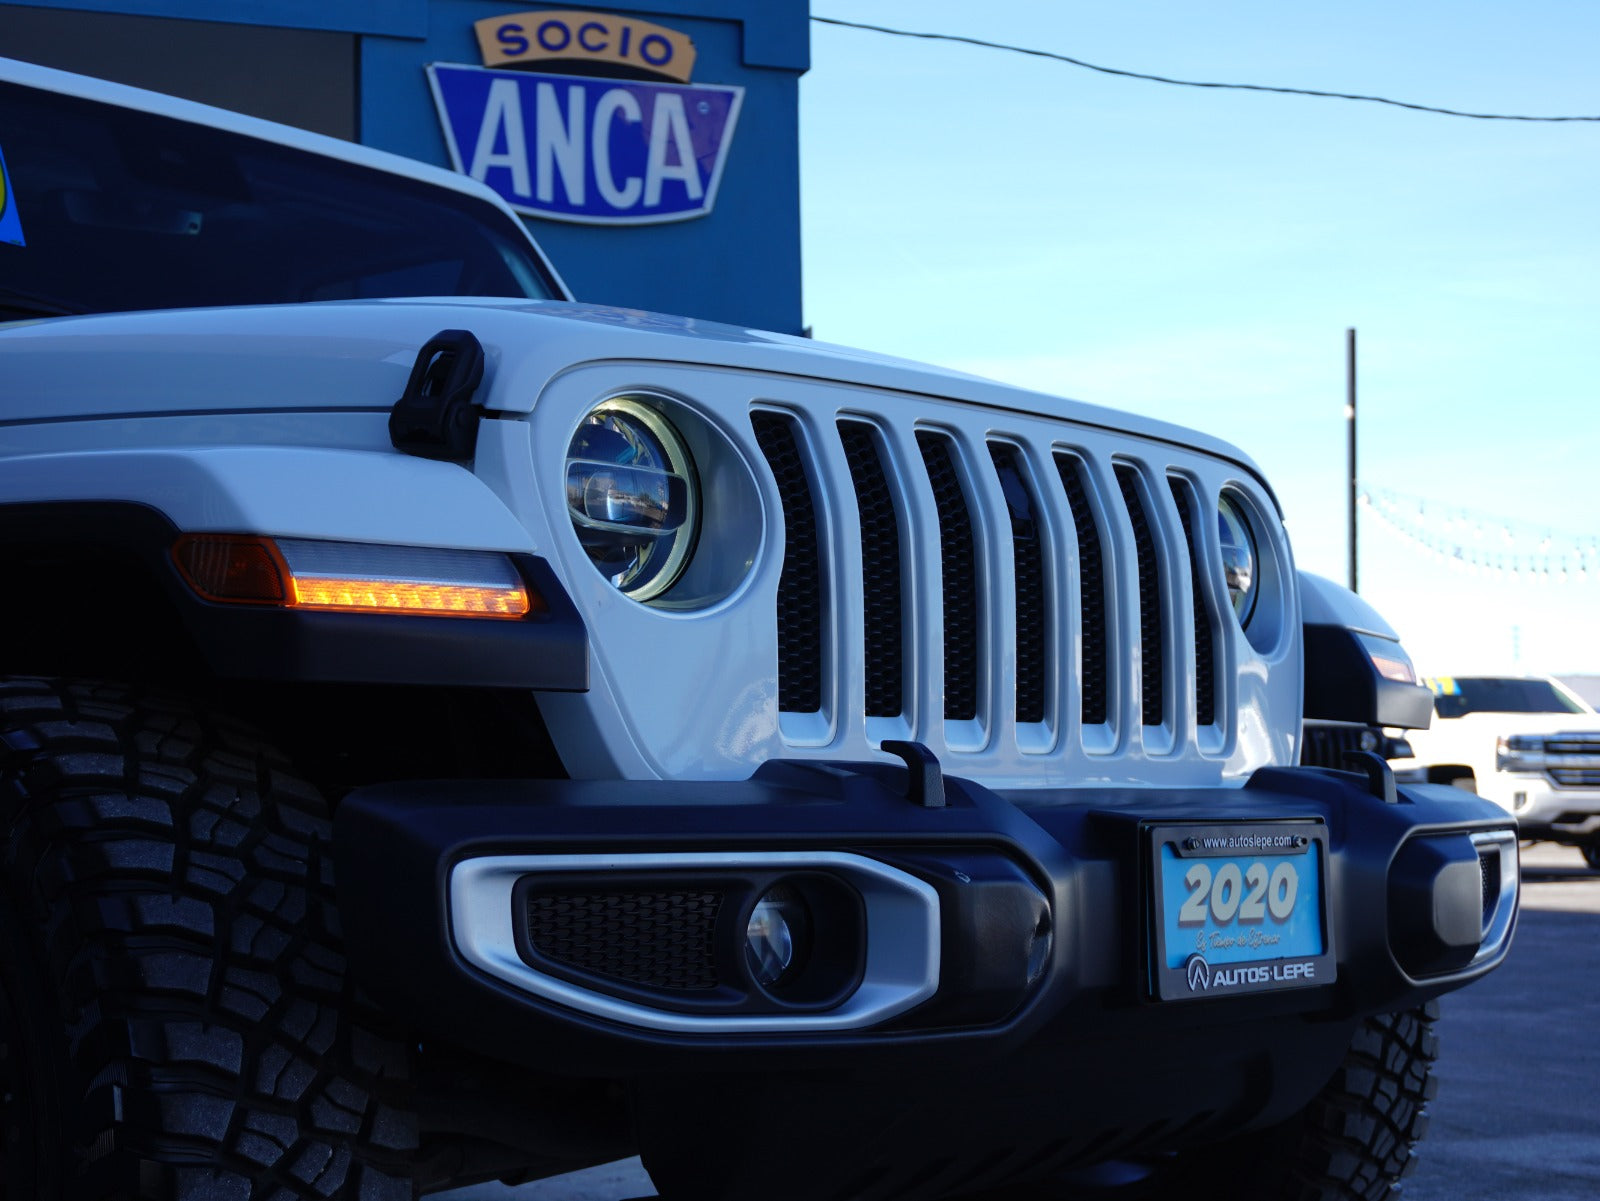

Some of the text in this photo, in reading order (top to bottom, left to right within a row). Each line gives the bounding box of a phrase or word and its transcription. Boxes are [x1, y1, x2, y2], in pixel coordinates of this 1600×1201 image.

[496, 20, 673, 66] SOCIO
[469, 78, 703, 209] ANCA
[1203, 836, 1292, 849] www.autoslepe.com
[1179, 861, 1299, 926] 2020
[1212, 962, 1315, 987] AUTOS LEPE
